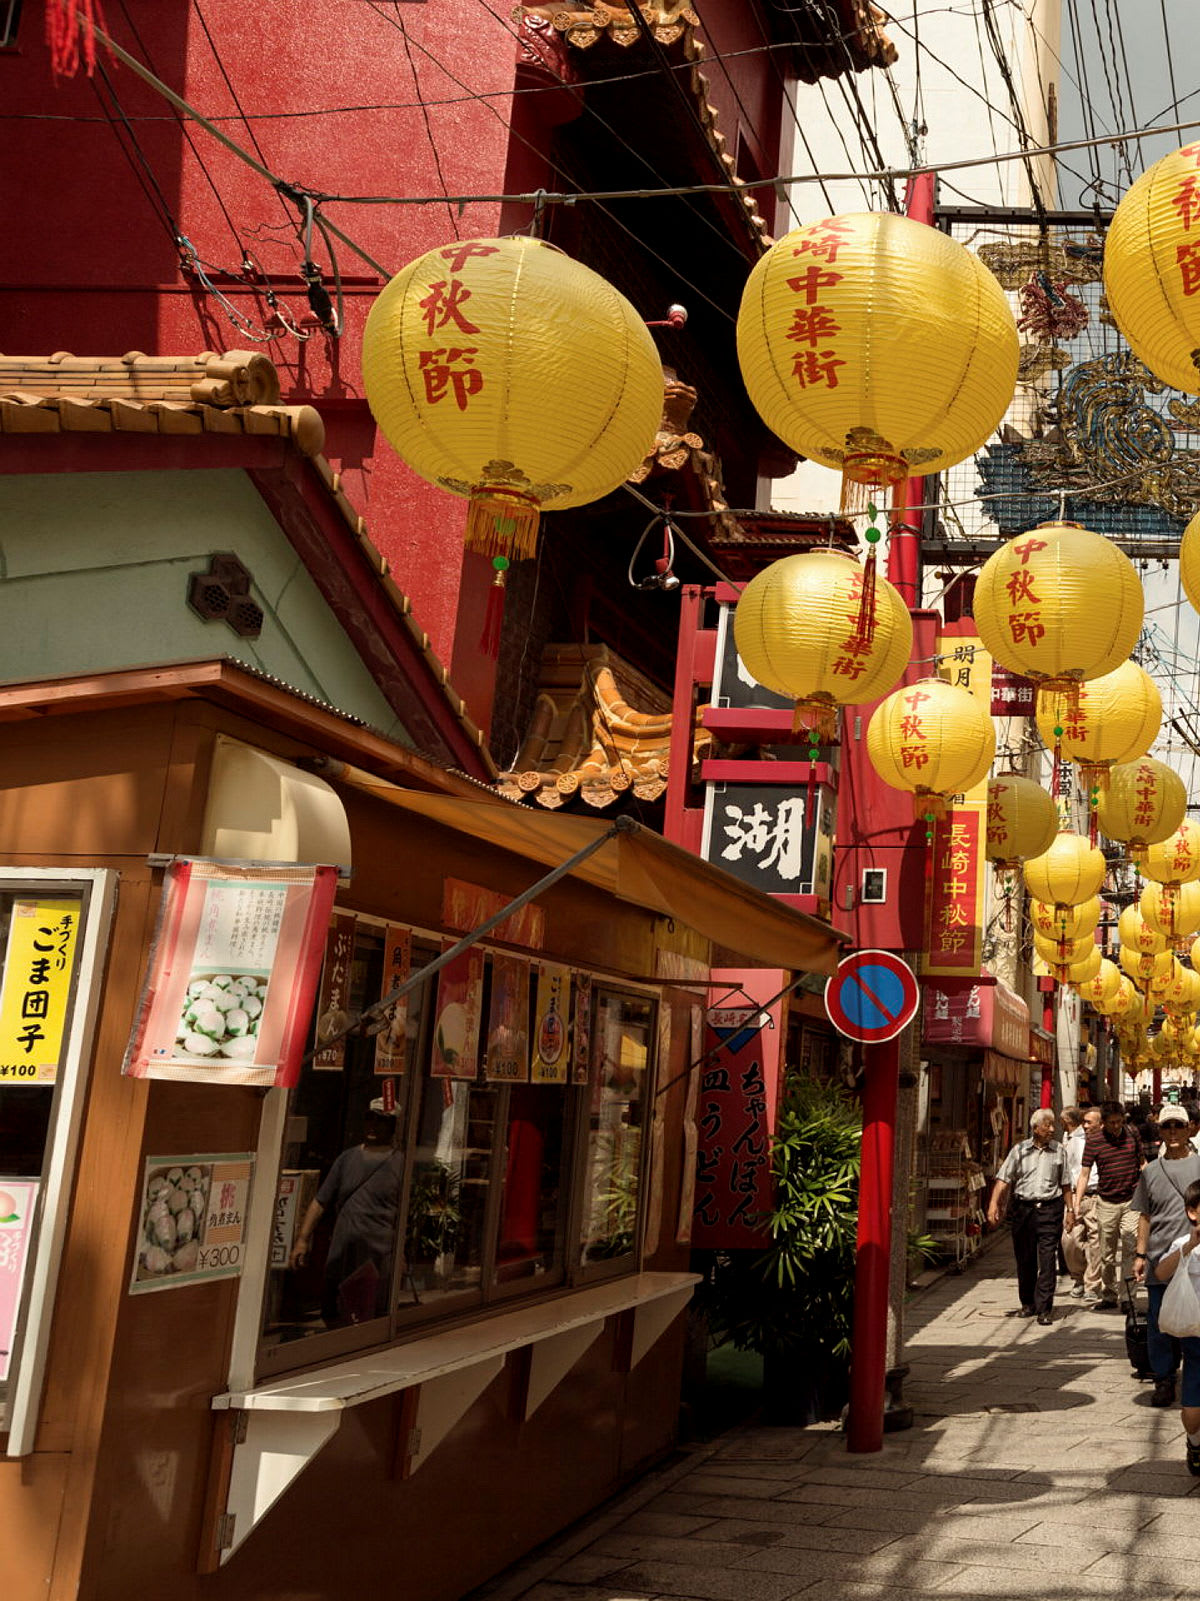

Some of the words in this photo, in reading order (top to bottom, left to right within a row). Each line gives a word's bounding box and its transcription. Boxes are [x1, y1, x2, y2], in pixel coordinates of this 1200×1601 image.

[418, 242, 501, 412] 中秋節
[785, 217, 856, 390] 長崎中華街
[1006, 538, 1048, 648] 中秋節
[900, 691, 932, 770] 中秋節
[986, 783, 1009, 846] 中秋節
[1134, 763, 1158, 828] 長崎中華街
[721, 797, 805, 880] 湖
[938, 823, 972, 955] 長崎中秋節
[1036, 902, 1052, 931] 秋節
[55, 914, 74, 971] 手づくり
[16, 926, 60, 1054] ごま団子
[329, 933, 352, 1037] ぶたまん
[0, 1064, 36, 1077] ¥100
[692, 1064, 733, 1228] 皿うどん
[728, 1061, 768, 1228] ちゃんぽん
[208, 1212, 242, 1229] 角煮まん
[219, 1182, 237, 1210] 桃
[199, 1246, 241, 1268] ¥300
